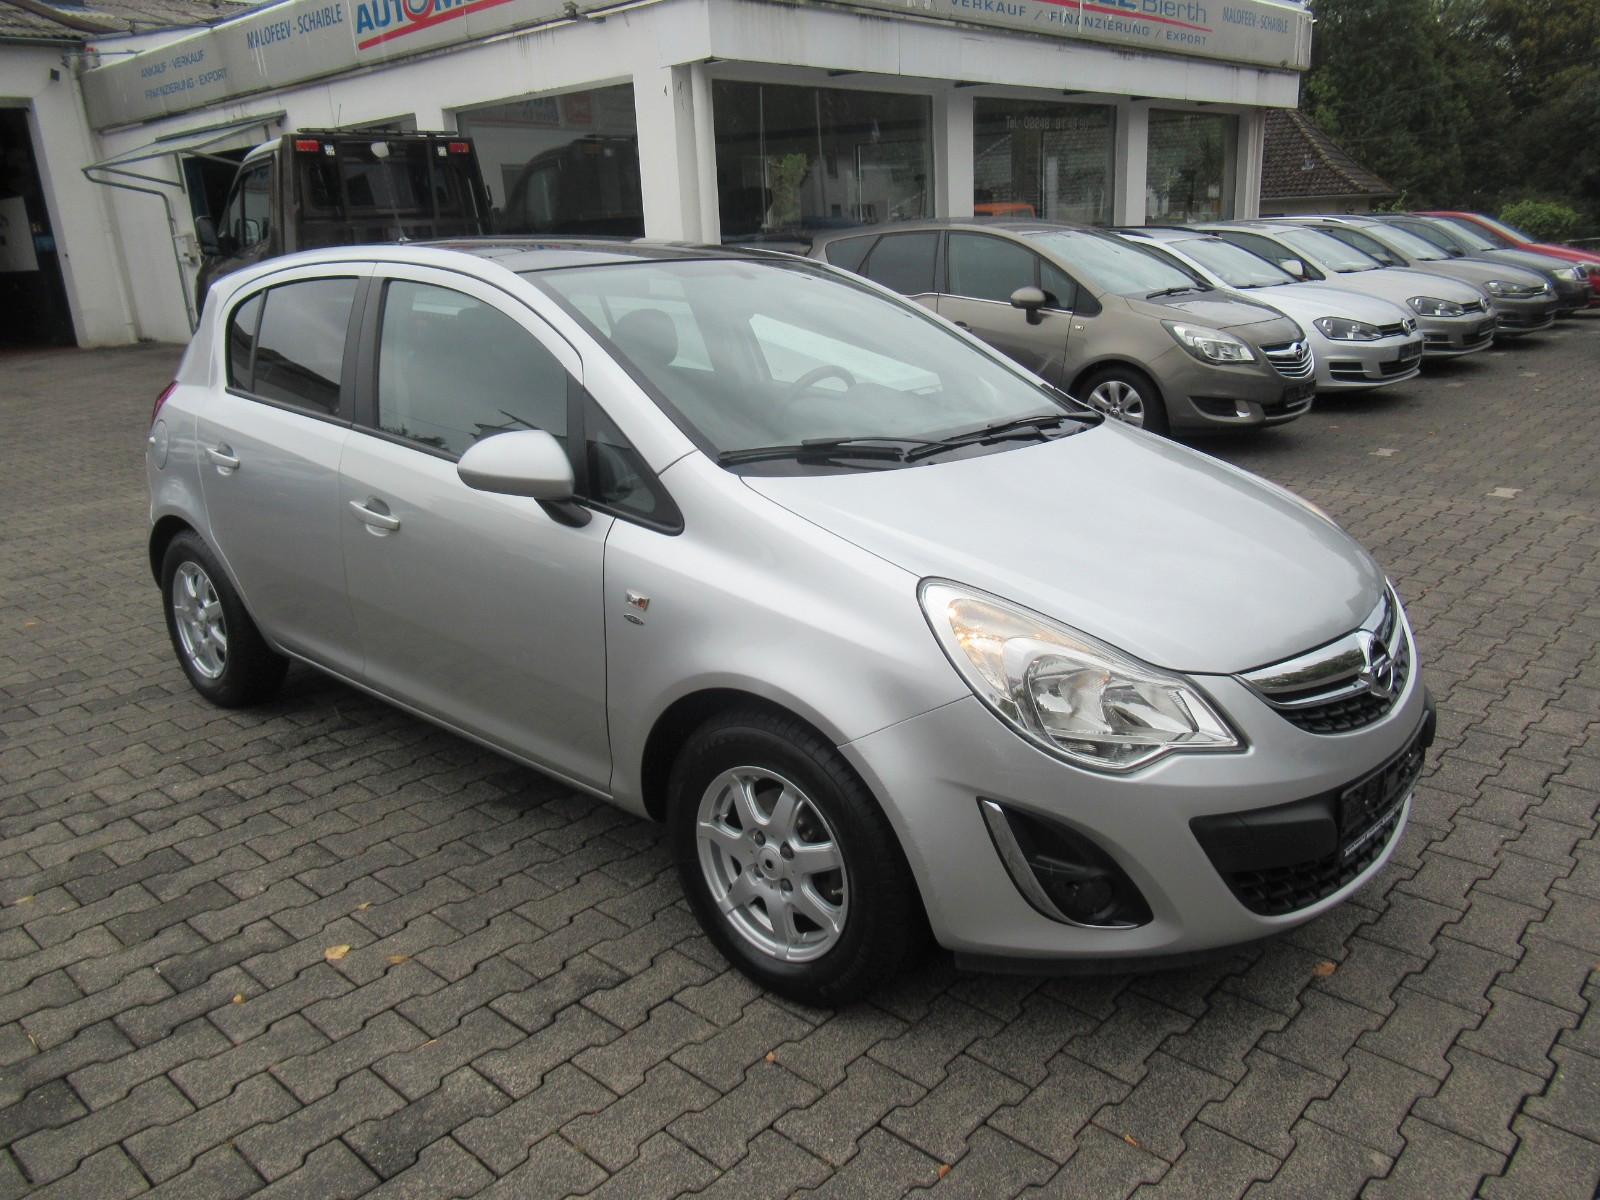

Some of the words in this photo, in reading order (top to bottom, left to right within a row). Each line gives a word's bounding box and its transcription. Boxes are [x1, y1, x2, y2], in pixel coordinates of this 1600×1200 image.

[247, 20, 291, 49] MALOFEEV
[297, 4, 343, 34] SCHAIBLE
[357, 0, 474, 33] AUTO
[1143, 0, 1206, 23] Bierth
[1050, 12, 1149, 36] FINANZIERUNG
[1166, 31, 1206, 45] EXPORT
[199, 67, 227, 85] EXPORT
